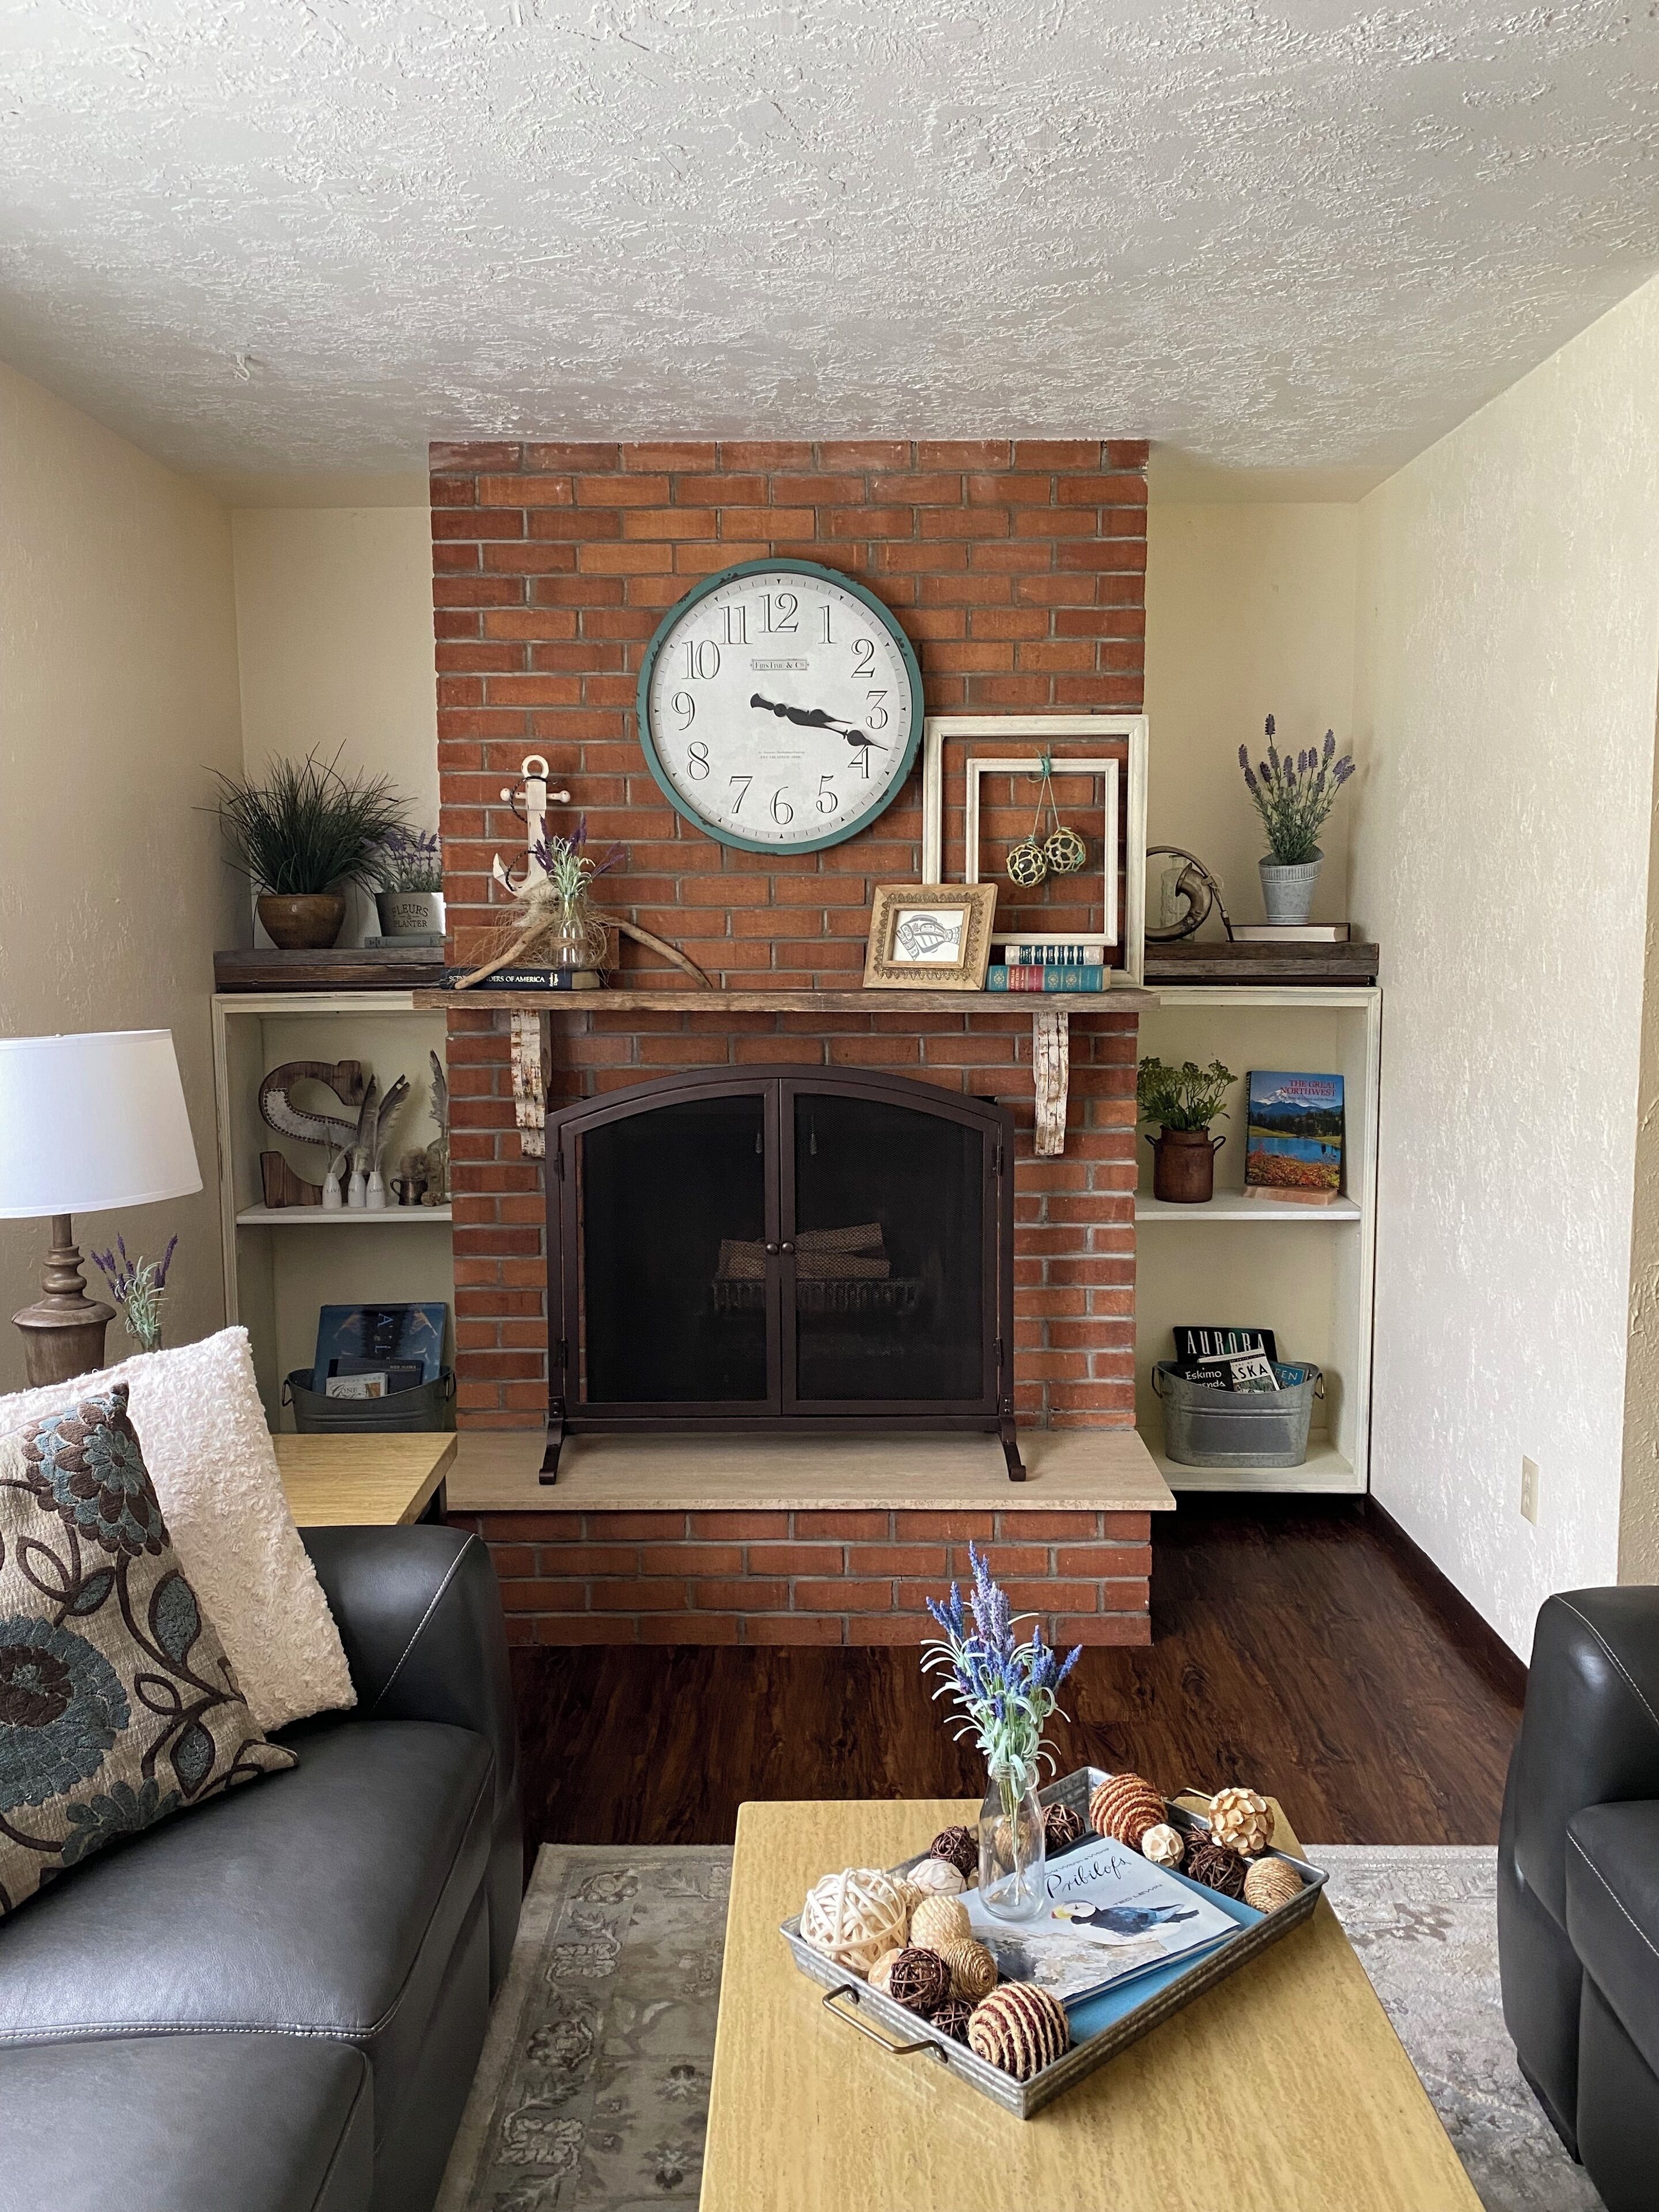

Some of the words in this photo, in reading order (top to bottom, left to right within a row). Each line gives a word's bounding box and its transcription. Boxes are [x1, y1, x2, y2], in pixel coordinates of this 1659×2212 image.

[718, 605, 753, 645] 11
[758, 593, 800, 633] 12
[818, 605, 837, 644] 1
[681, 640, 721, 680] 10
[851, 639, 876, 679] 2
[671, 692, 695, 730] 9
[865, 690, 888, 730] 3
[686, 741, 710, 781] 8
[847, 744, 870, 779] 4
[729, 775, 753, 814] 7
[770, 786, 794, 825] 6
[816, 775, 838, 814] 5
[392, 904, 429, 917] FLEURS
[1281, 1087, 1336, 1097] NORTHWEST
[1185, 1367, 1222, 1380] Eskimo
[1232, 1363, 1268, 1380] ASKA
[1044, 1855, 1132, 1899] Pribilofs
[1113, 1897, 1132, 1906] TED
[1133, 1884, 1162, 1898] LEWIN
